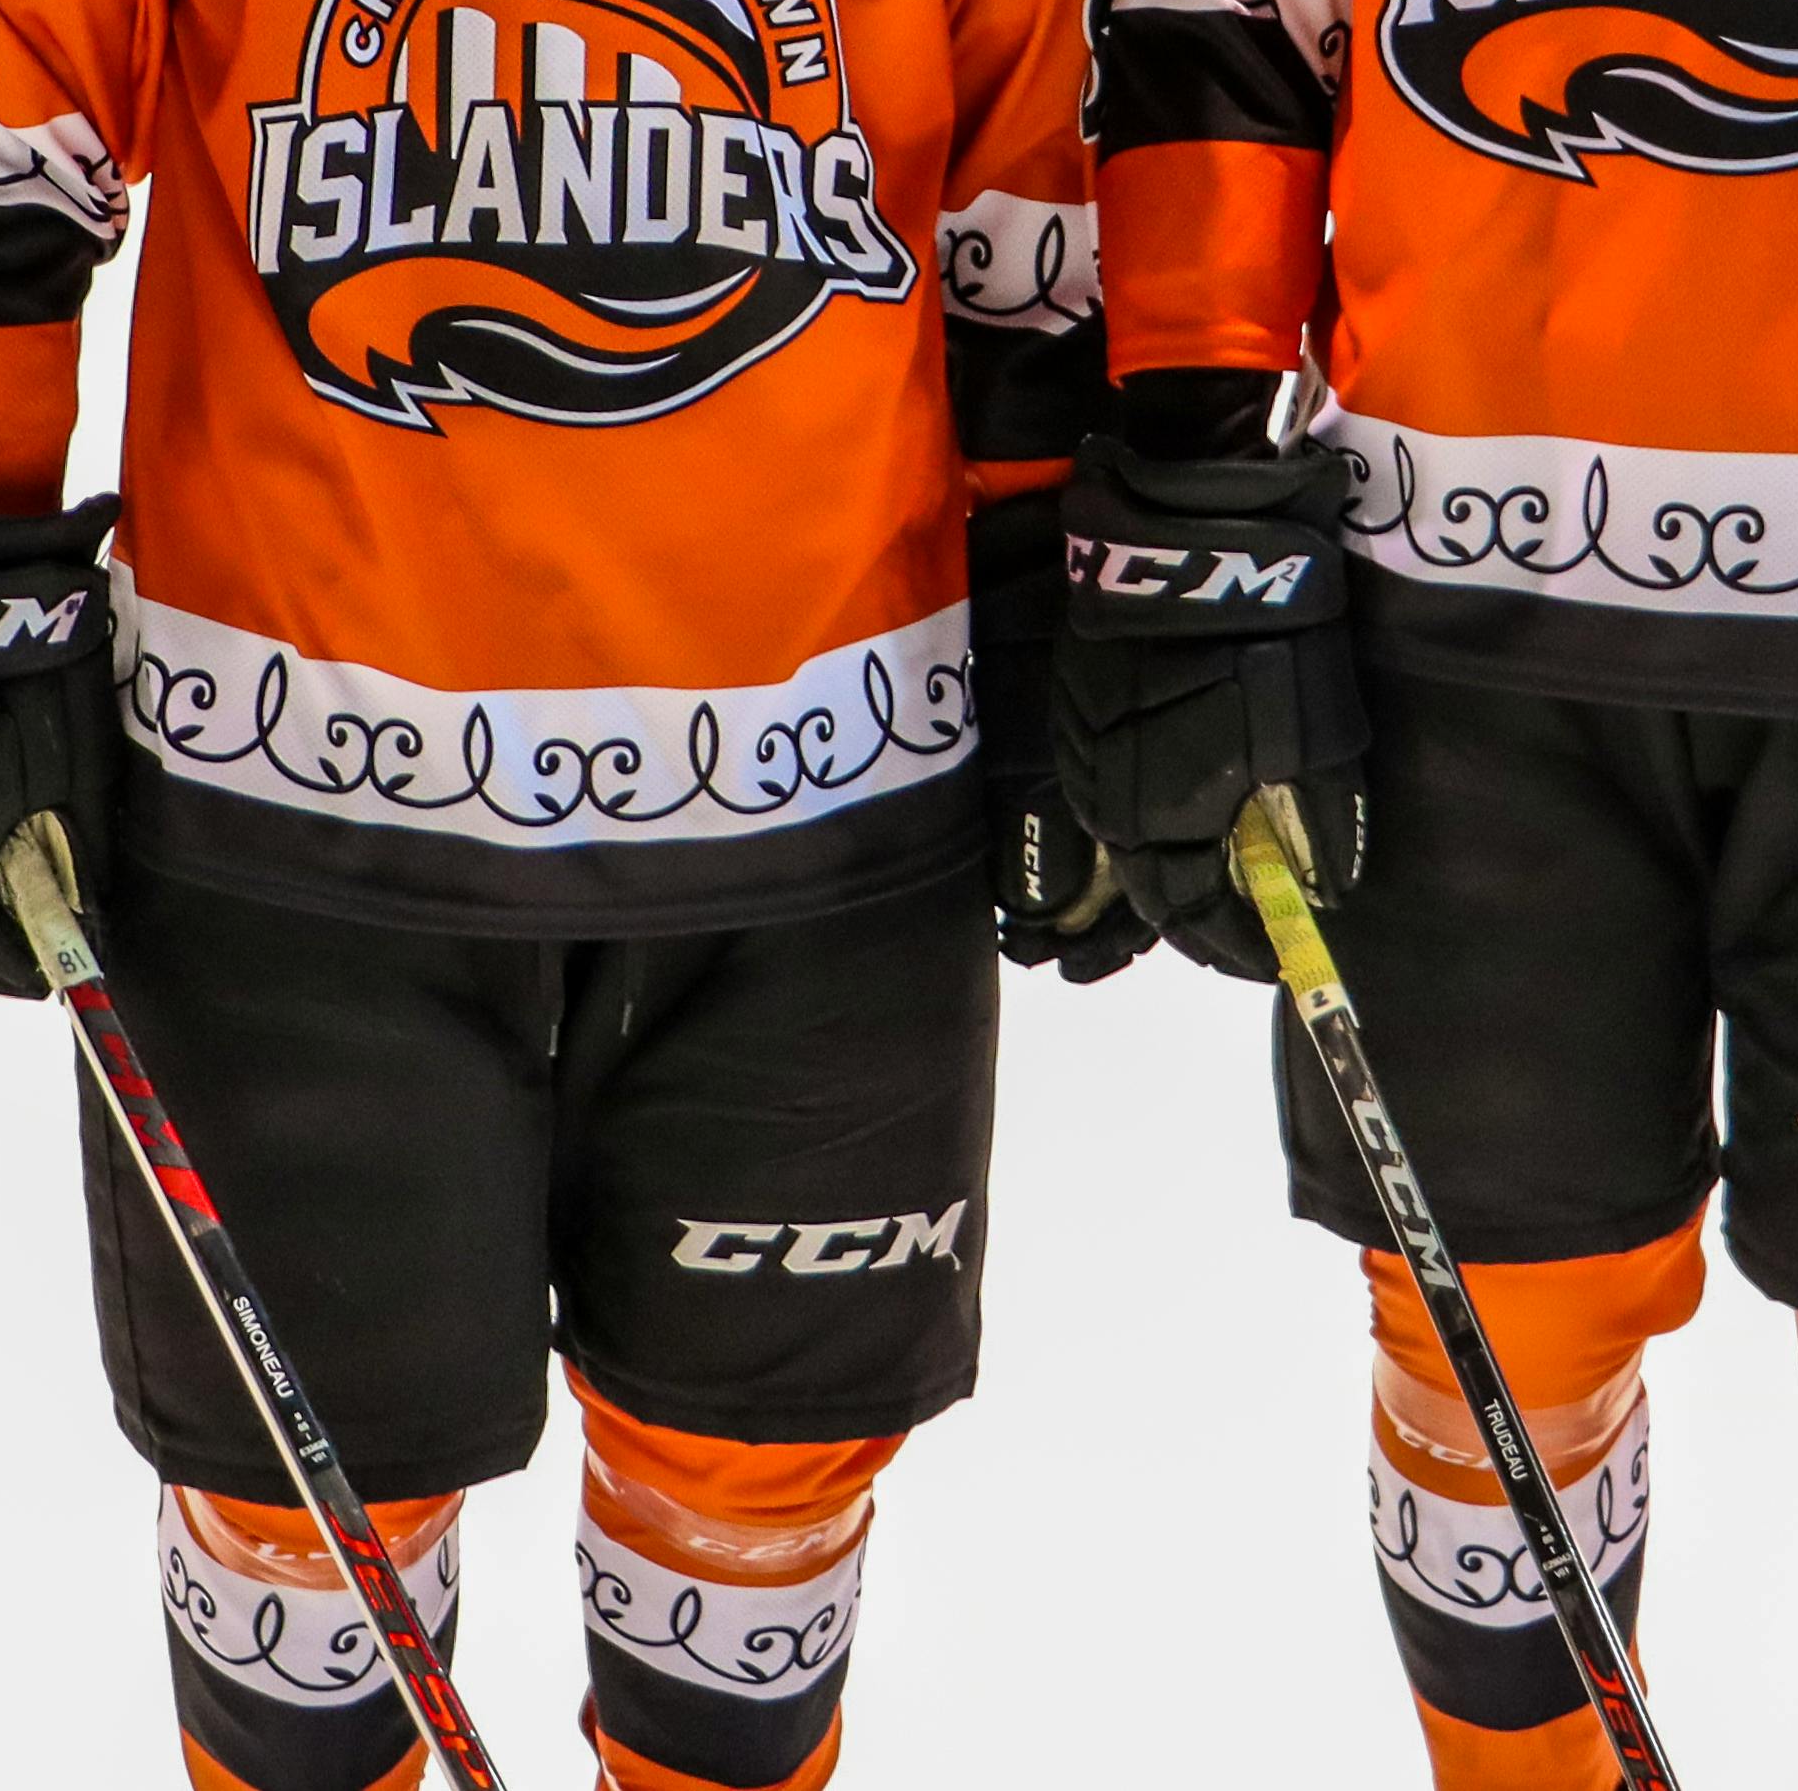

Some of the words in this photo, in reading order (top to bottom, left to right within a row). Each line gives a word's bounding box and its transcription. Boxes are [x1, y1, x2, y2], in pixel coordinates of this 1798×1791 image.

[254, 103, 901, 288] ISLANDERS
[1065, 532, 1311, 604] CCM
[1023, 812, 1043, 903] CCM
[671, 1200, 967, 1274] CCM
[1352, 1098, 1457, 1289] CCM
[233, 1296, 294, 1400] SIMONEAU
[1484, 1397, 1528, 1482] TRUDEAU
